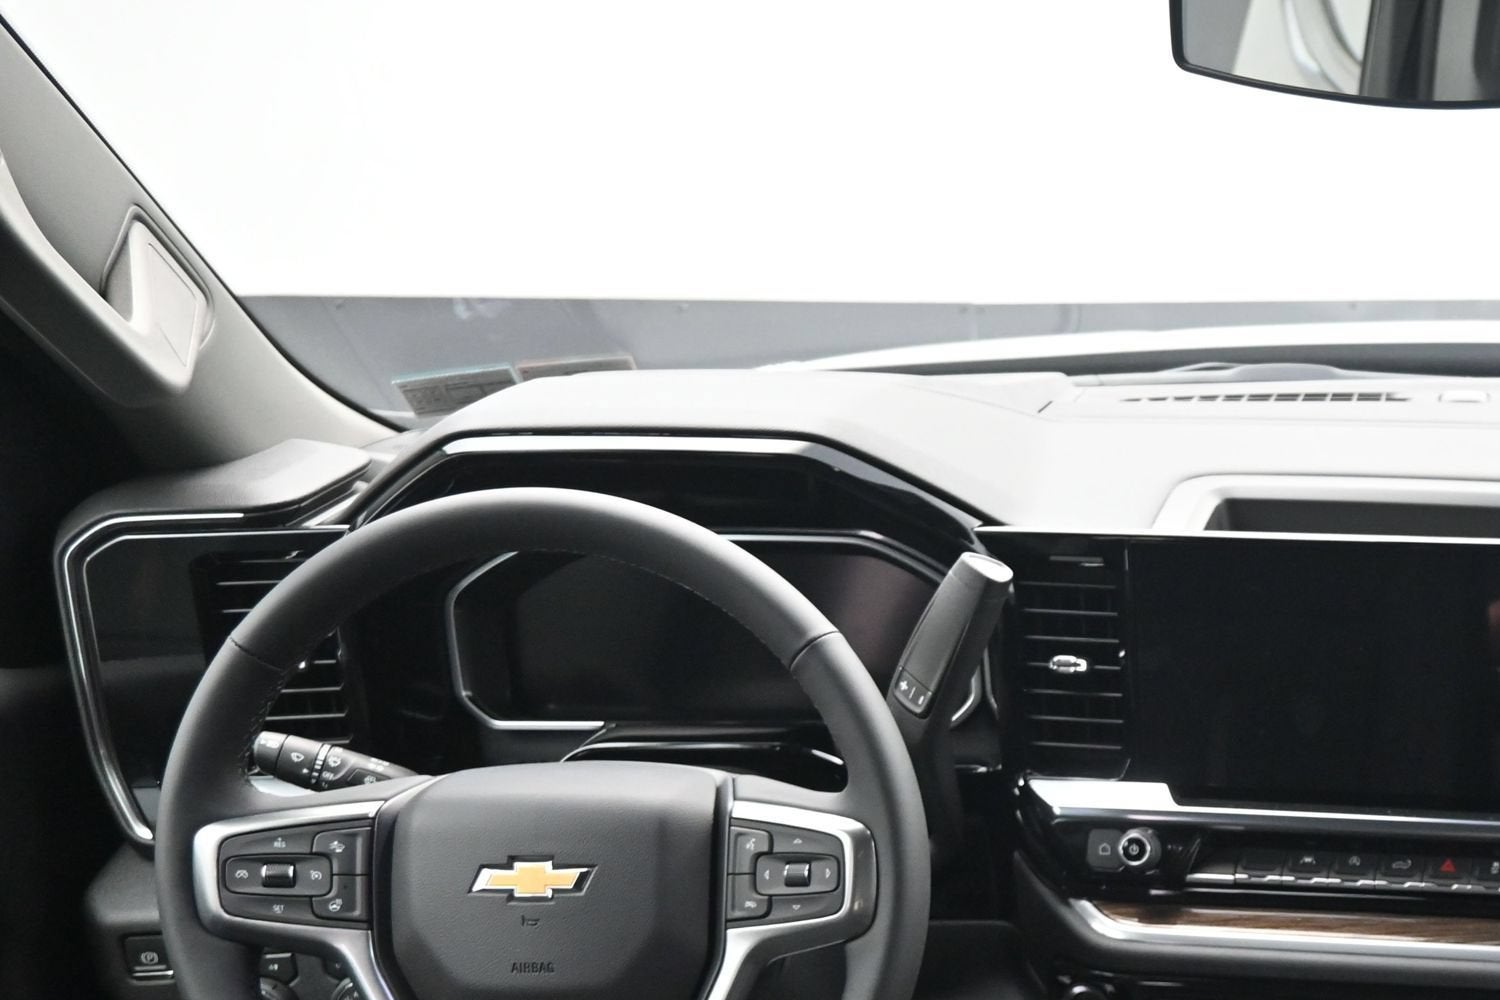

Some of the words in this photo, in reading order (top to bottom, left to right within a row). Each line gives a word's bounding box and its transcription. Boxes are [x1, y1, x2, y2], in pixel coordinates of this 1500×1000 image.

[273, 841, 287, 849] RES
[272, 904, 285, 912] SET
[511, 961, 555, 974] AIRBAG
